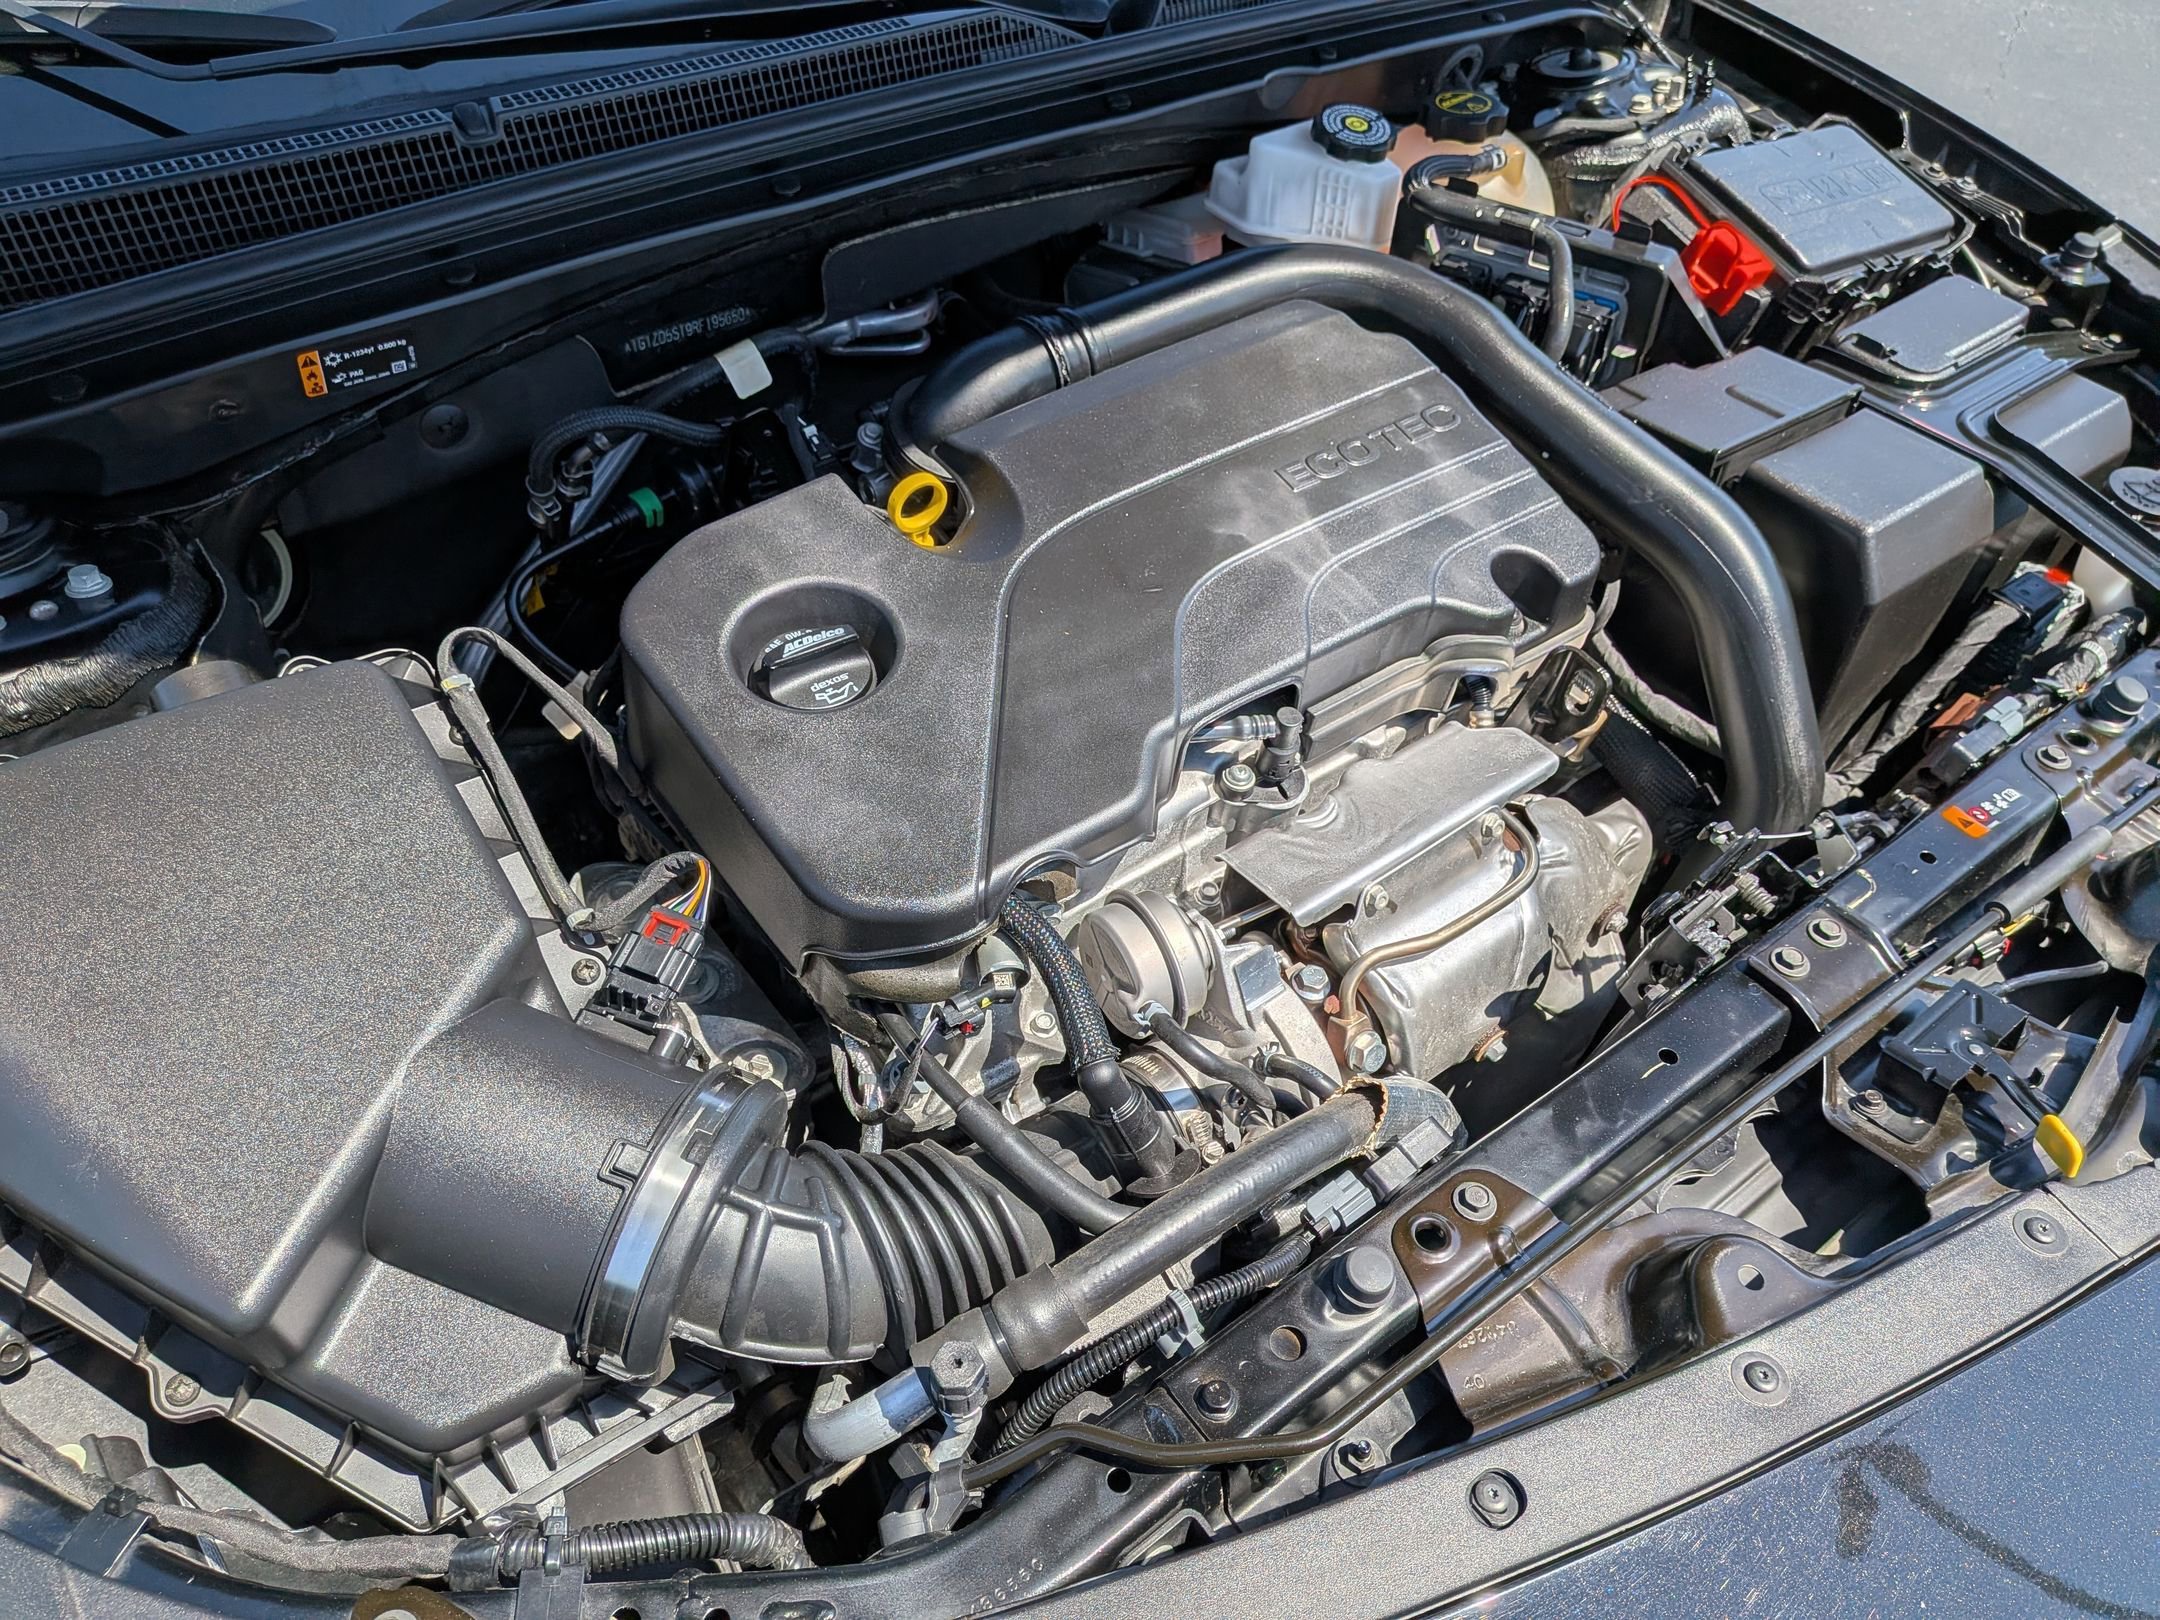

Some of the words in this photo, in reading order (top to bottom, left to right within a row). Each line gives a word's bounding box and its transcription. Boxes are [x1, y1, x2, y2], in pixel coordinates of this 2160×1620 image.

[1274, 404, 1461, 493] ECOTEC
[782, 627, 845, 657] ACDelco
[810, 672, 849, 693] dexos
